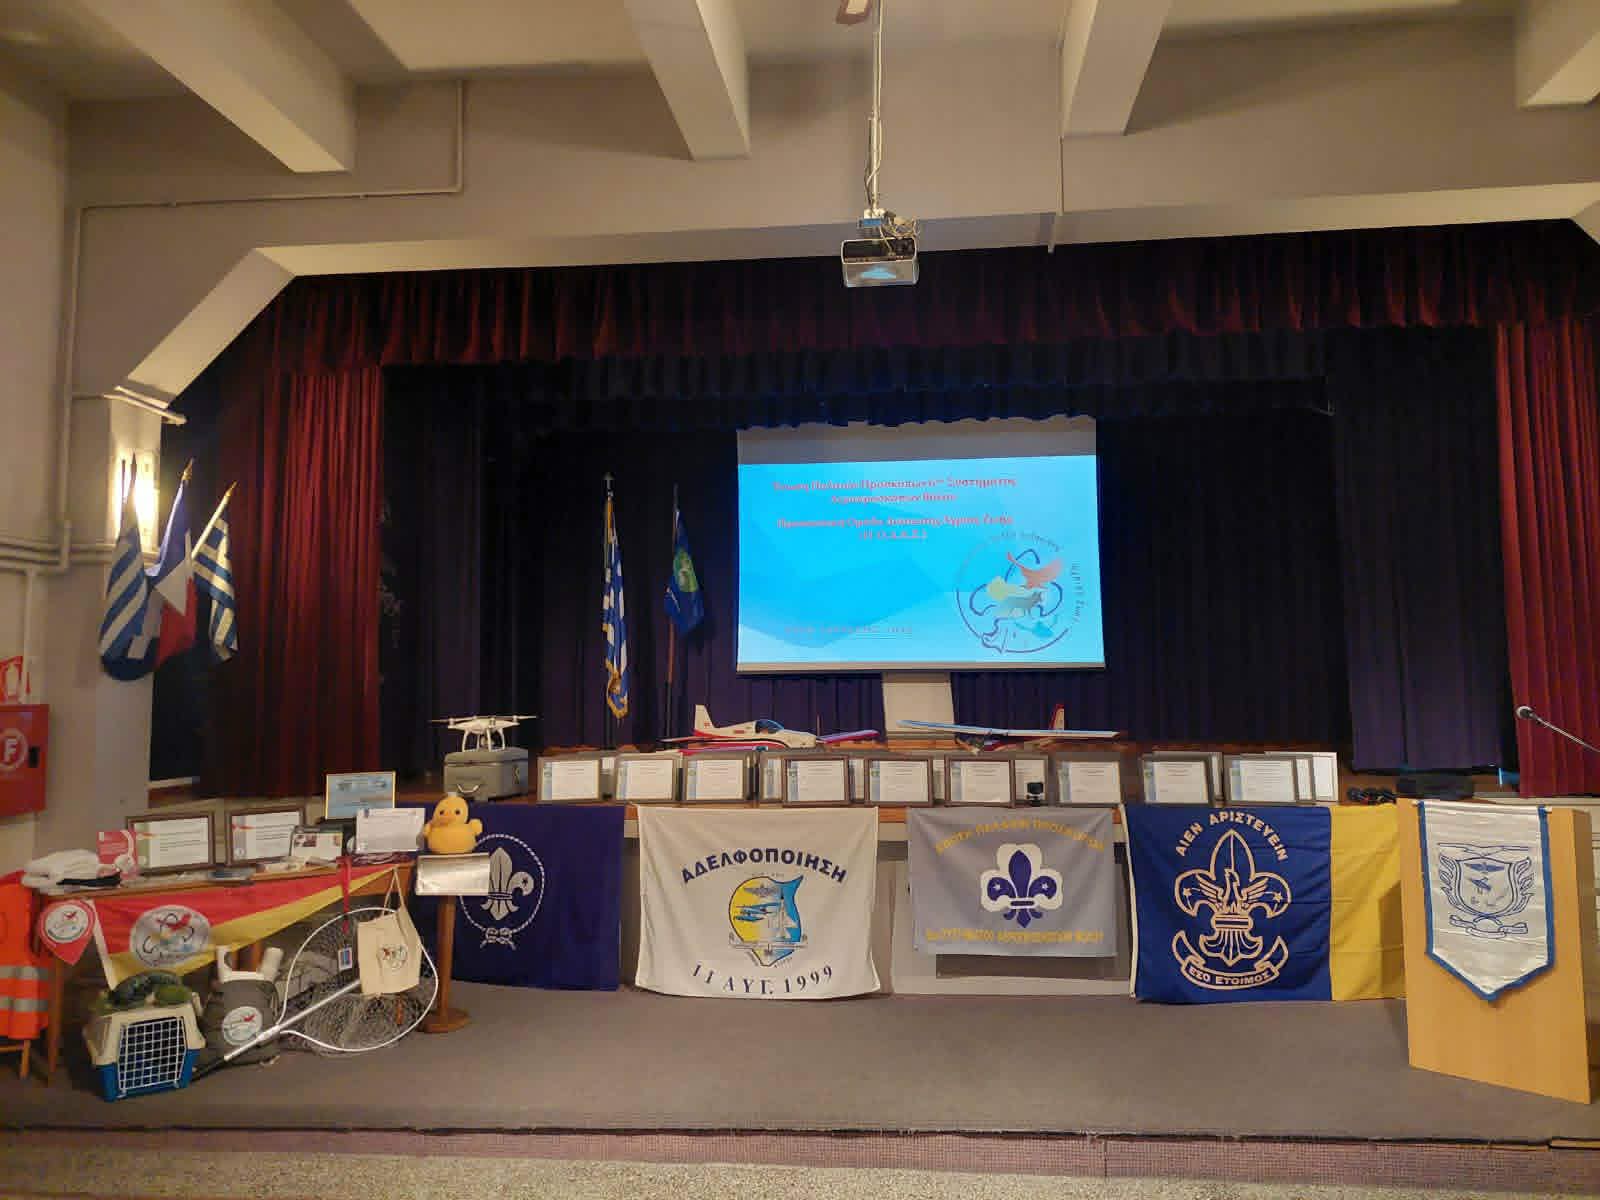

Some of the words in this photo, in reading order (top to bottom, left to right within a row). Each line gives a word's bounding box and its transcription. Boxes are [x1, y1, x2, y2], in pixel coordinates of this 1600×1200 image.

[1175, 822, 1204, 857] ΑΙΕΝ
[681, 848, 847, 884] ΑΔΕΛΦΟΠΟΙΗΣΗ
[784, 965, 832, 993] 1999
[1215, 970, 1271, 986] ΕΤΟΙΜΟΣ
